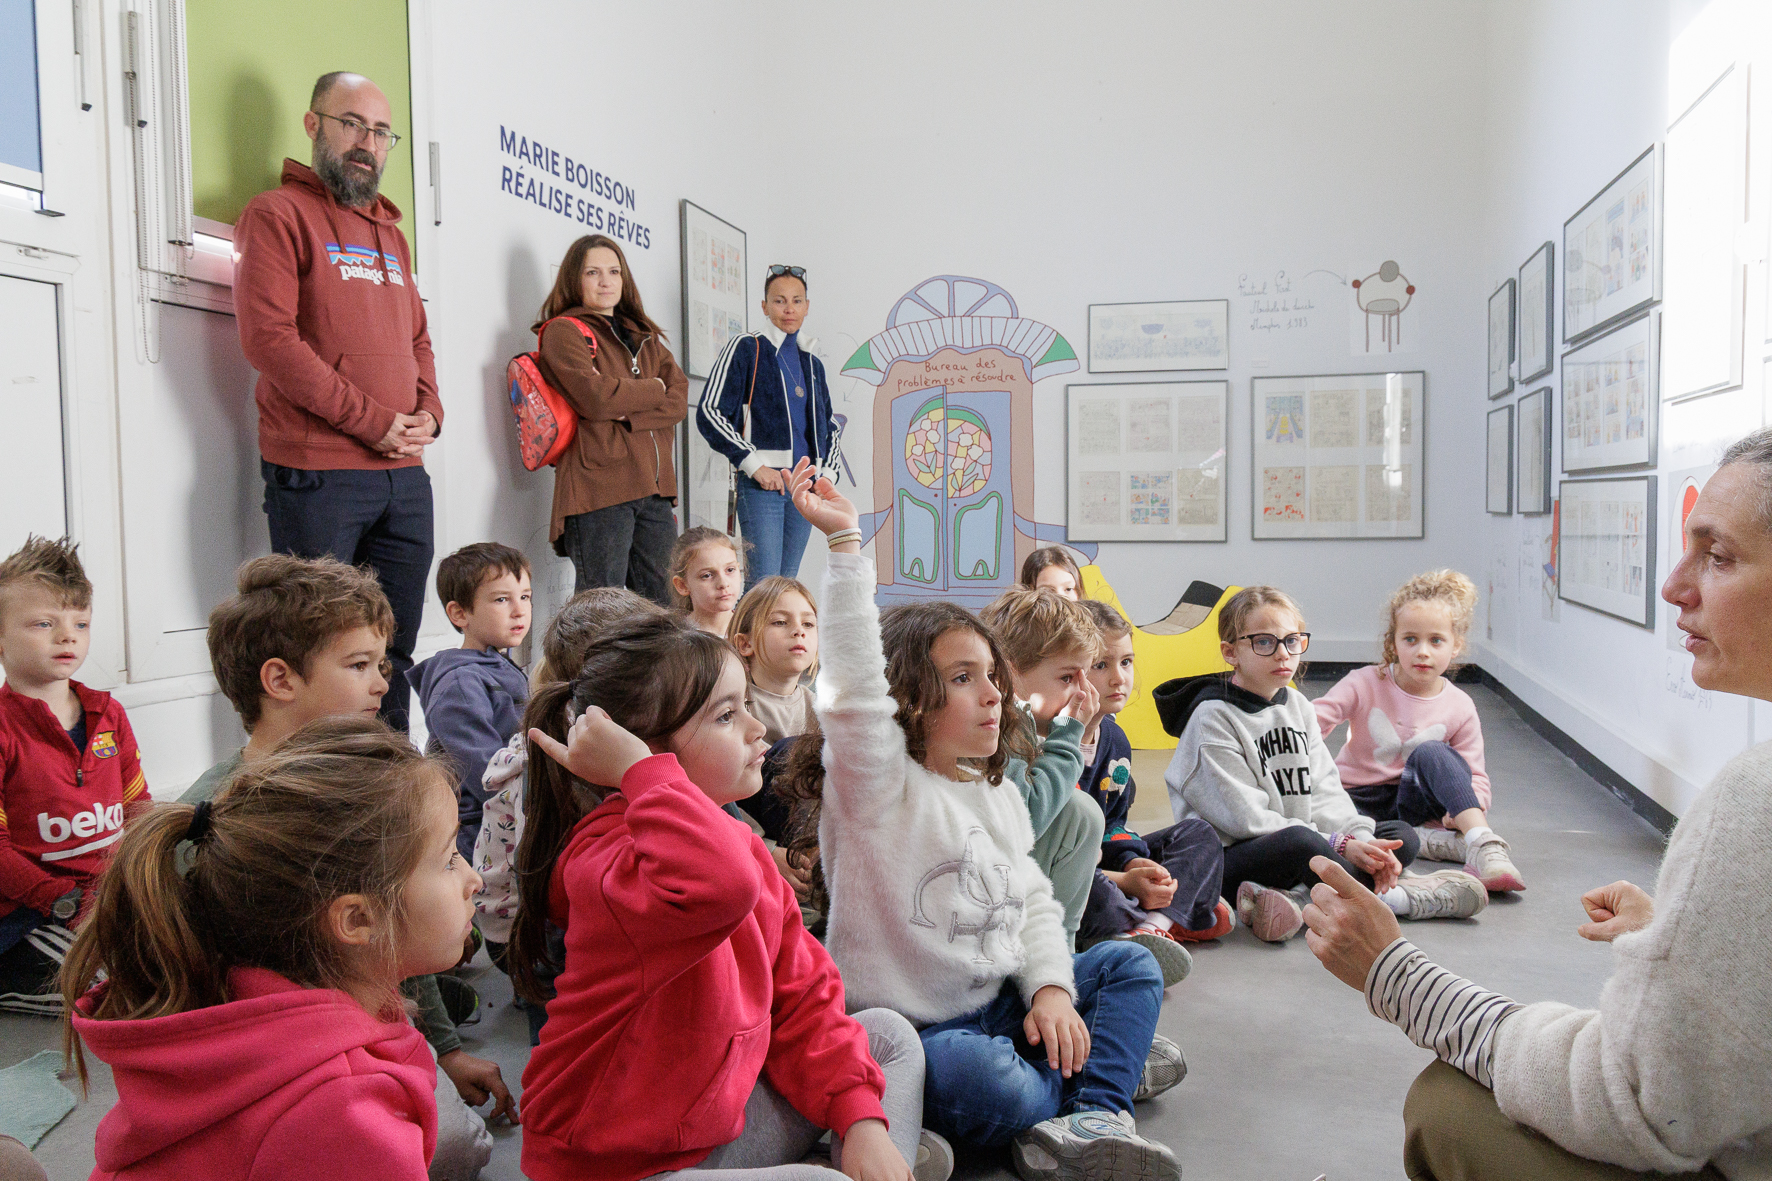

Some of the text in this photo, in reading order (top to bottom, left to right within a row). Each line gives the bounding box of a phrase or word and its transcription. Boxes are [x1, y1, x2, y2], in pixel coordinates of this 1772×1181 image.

[500, 124, 635, 211] MARIE BOISSON
[501, 165, 650, 250] RÉALISE SES RÊVES
[897, 369, 1016, 392] problèmes à résoudre
[924, 357, 996, 373] Bureau des
[37, 802, 124, 843] beko
